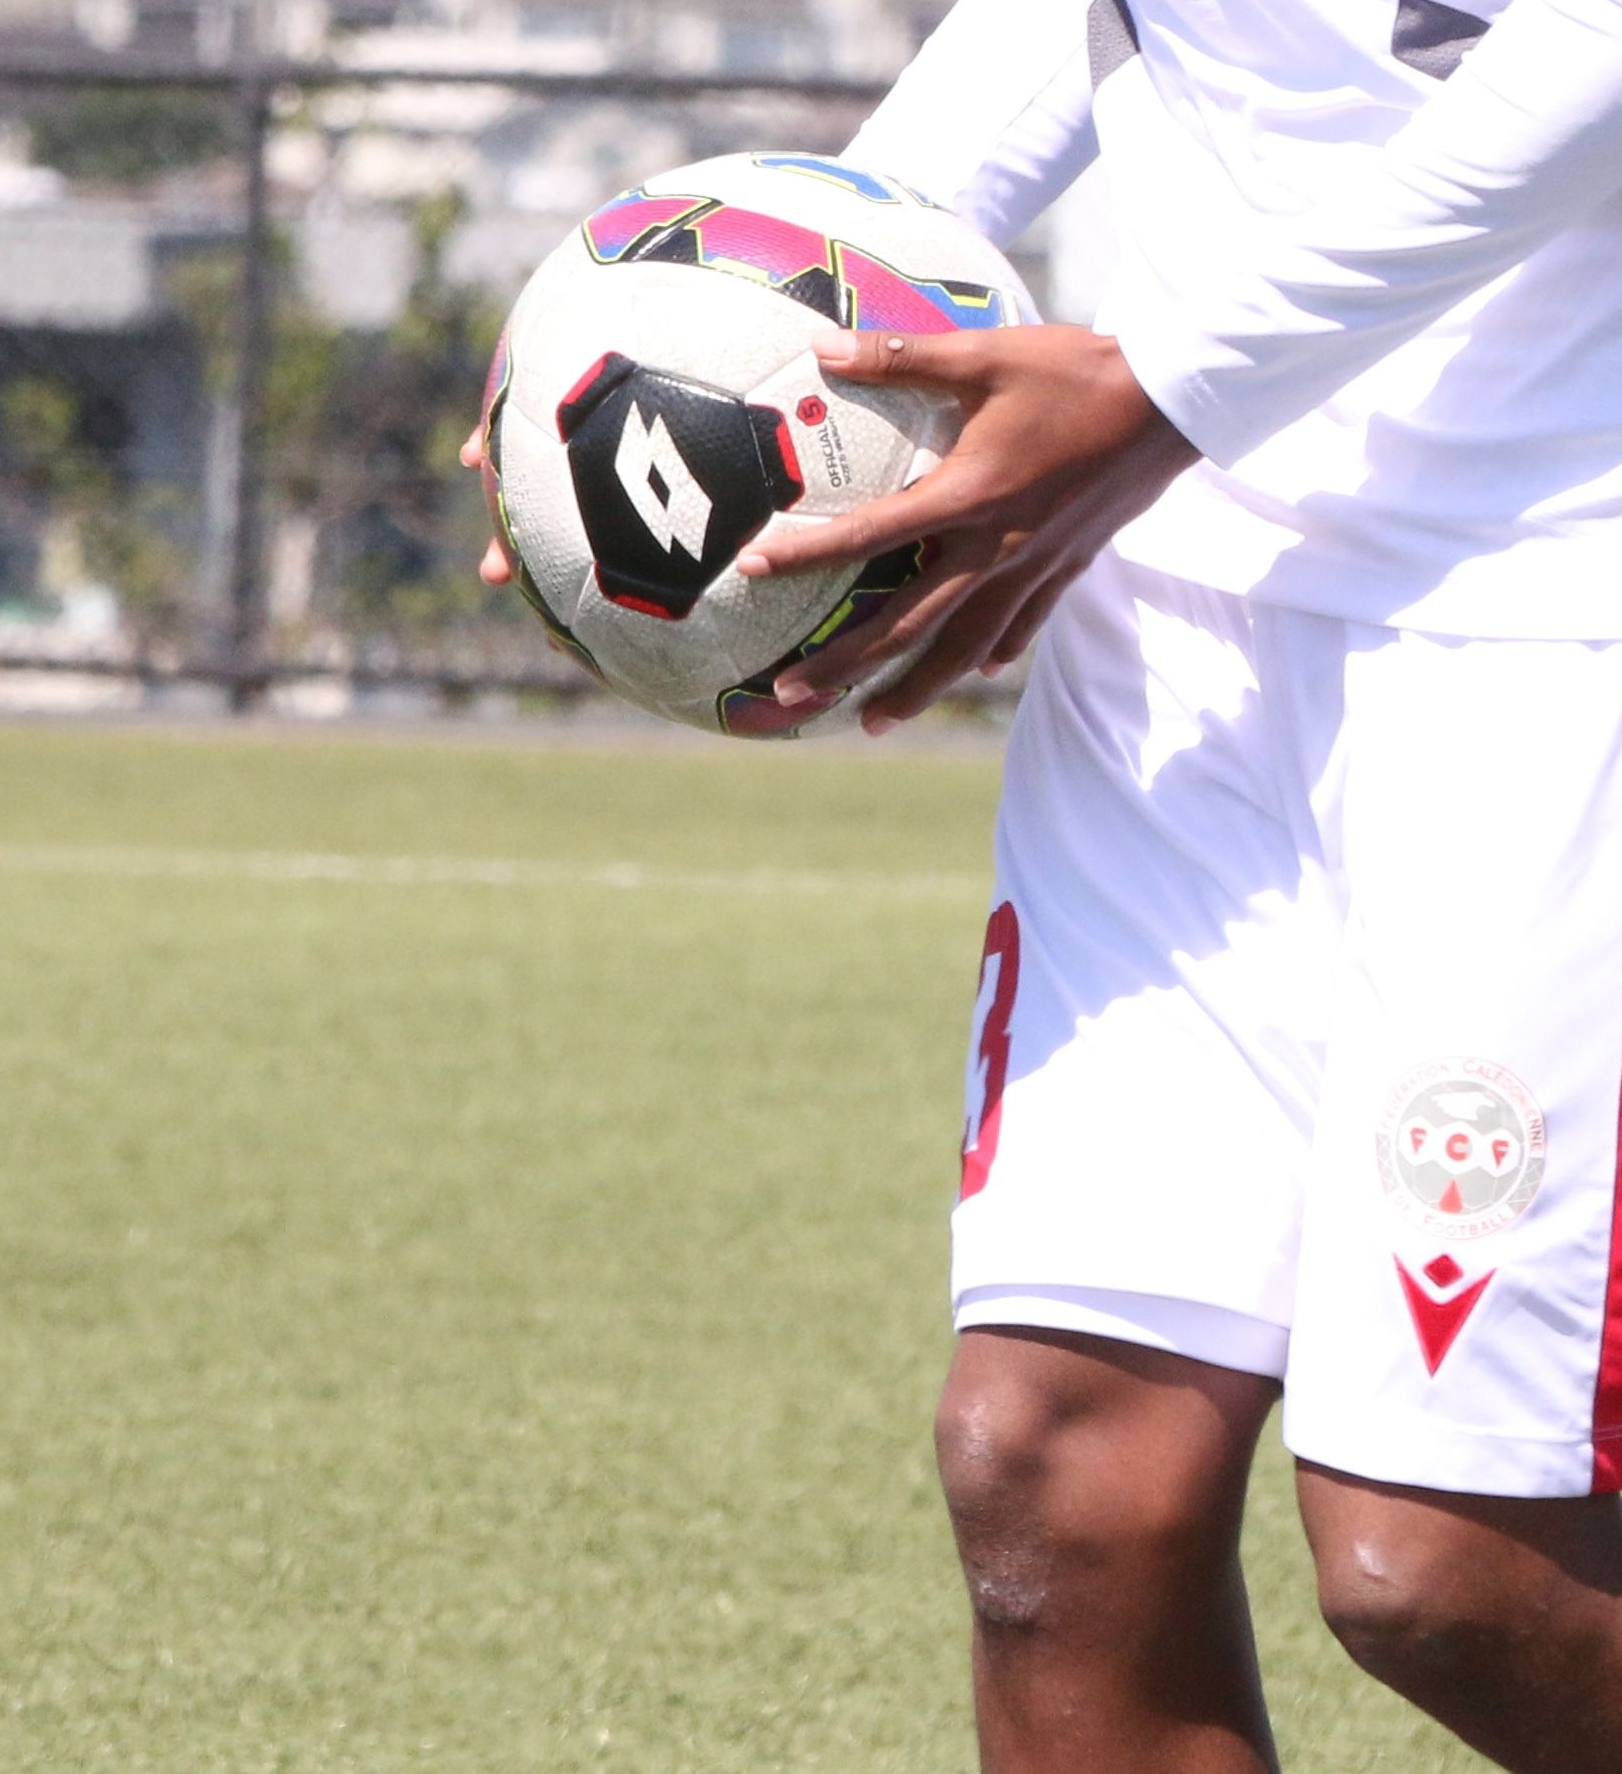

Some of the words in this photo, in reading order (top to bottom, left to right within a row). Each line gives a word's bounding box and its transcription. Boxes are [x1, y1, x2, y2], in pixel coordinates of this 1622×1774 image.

[801, 402, 822, 419] 5
[817, 425, 843, 488] OFFICIAL
[960, 900, 1020, 1203] 3
[1410, 1126, 1511, 1170] FCF
